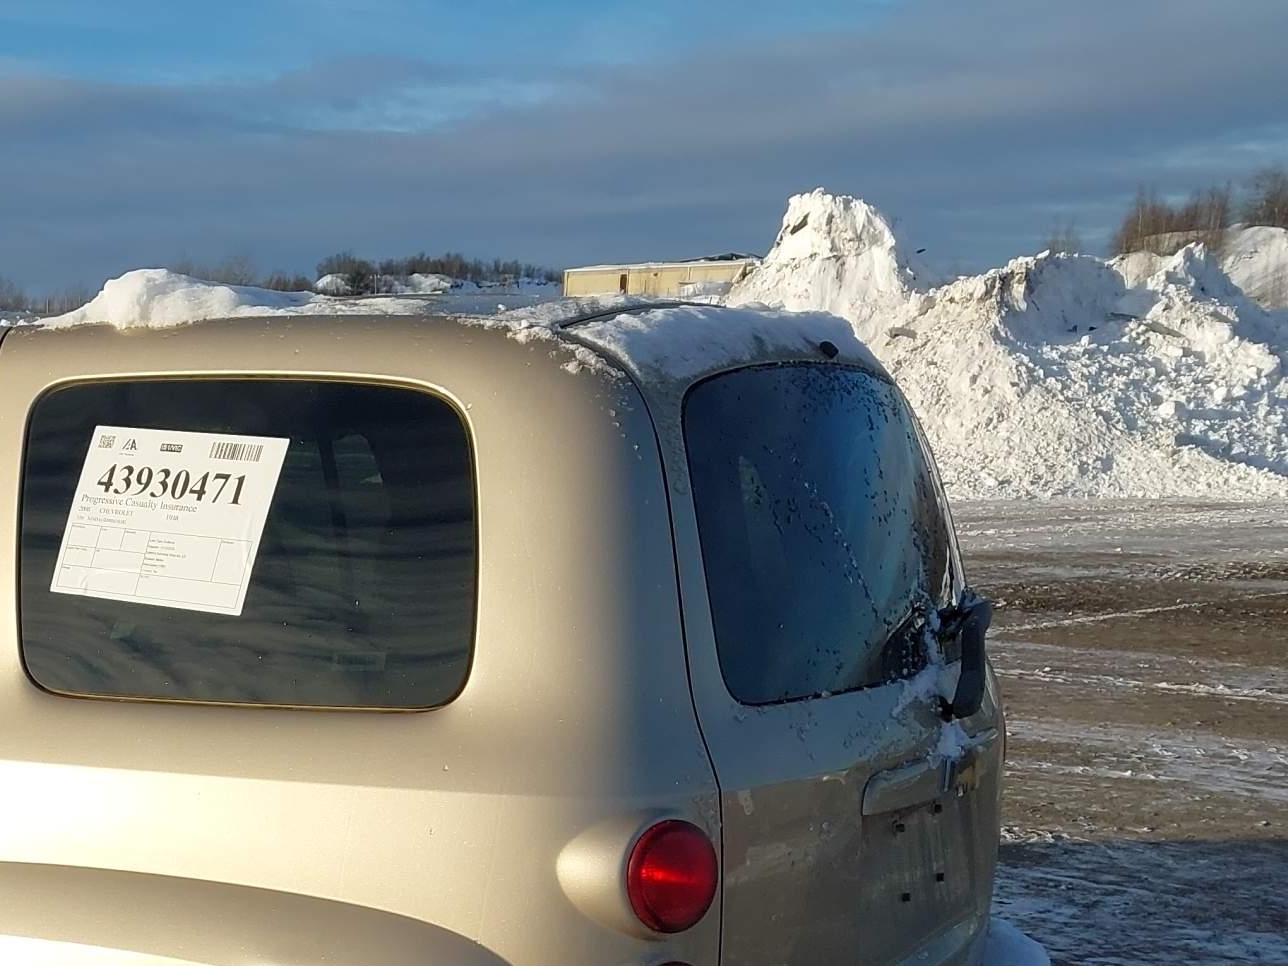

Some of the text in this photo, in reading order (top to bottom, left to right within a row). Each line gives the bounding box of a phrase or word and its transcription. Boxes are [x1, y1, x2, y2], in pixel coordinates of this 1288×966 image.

[96, 463, 247, 506] 43930471
[81, 494, 198, 513] Progressive Casualty Insurance
